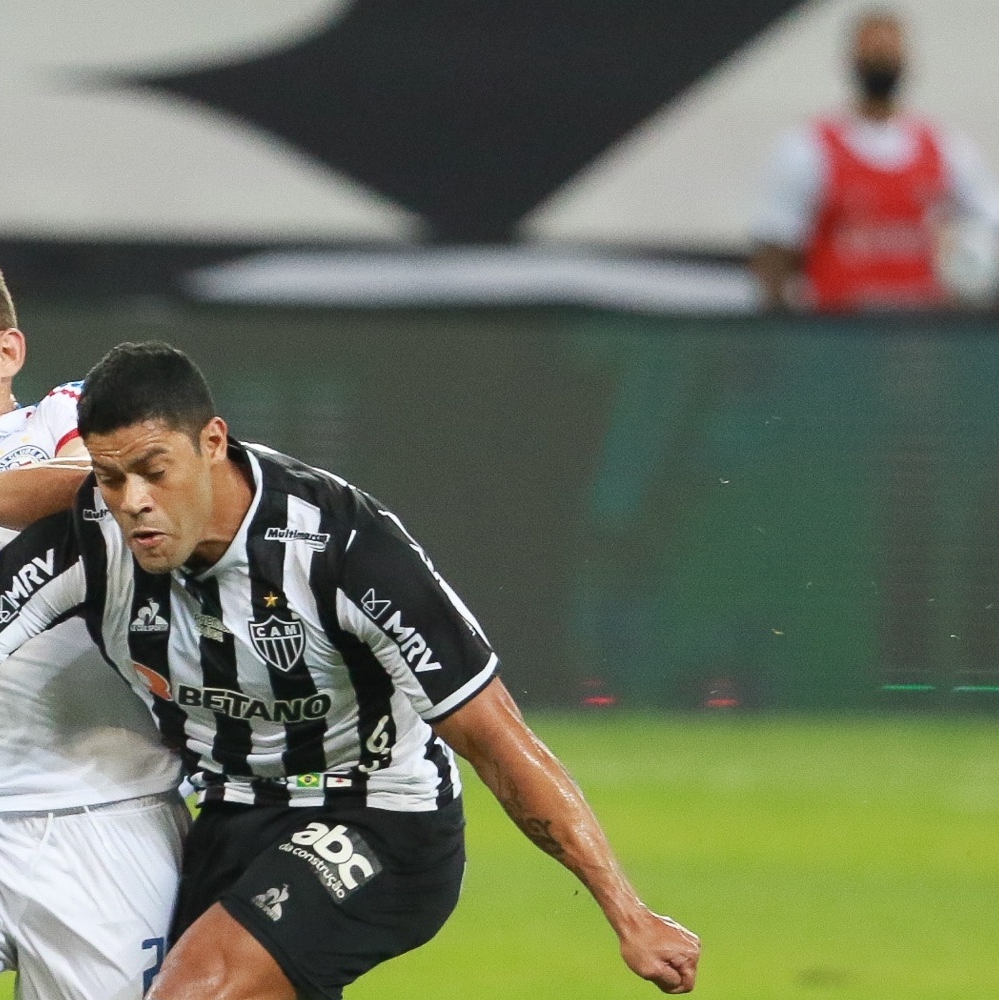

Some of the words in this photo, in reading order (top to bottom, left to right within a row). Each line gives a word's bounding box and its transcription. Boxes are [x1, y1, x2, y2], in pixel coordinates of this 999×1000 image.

[4, 548, 55, 609] MRV
[256, 625, 298, 637] CAM
[382, 610, 442, 673] MRV
[177, 683, 333, 723] BETANO
[278, 842, 295, 853] da
[292, 847, 346, 899] construção
[290, 821, 375, 891] abc
